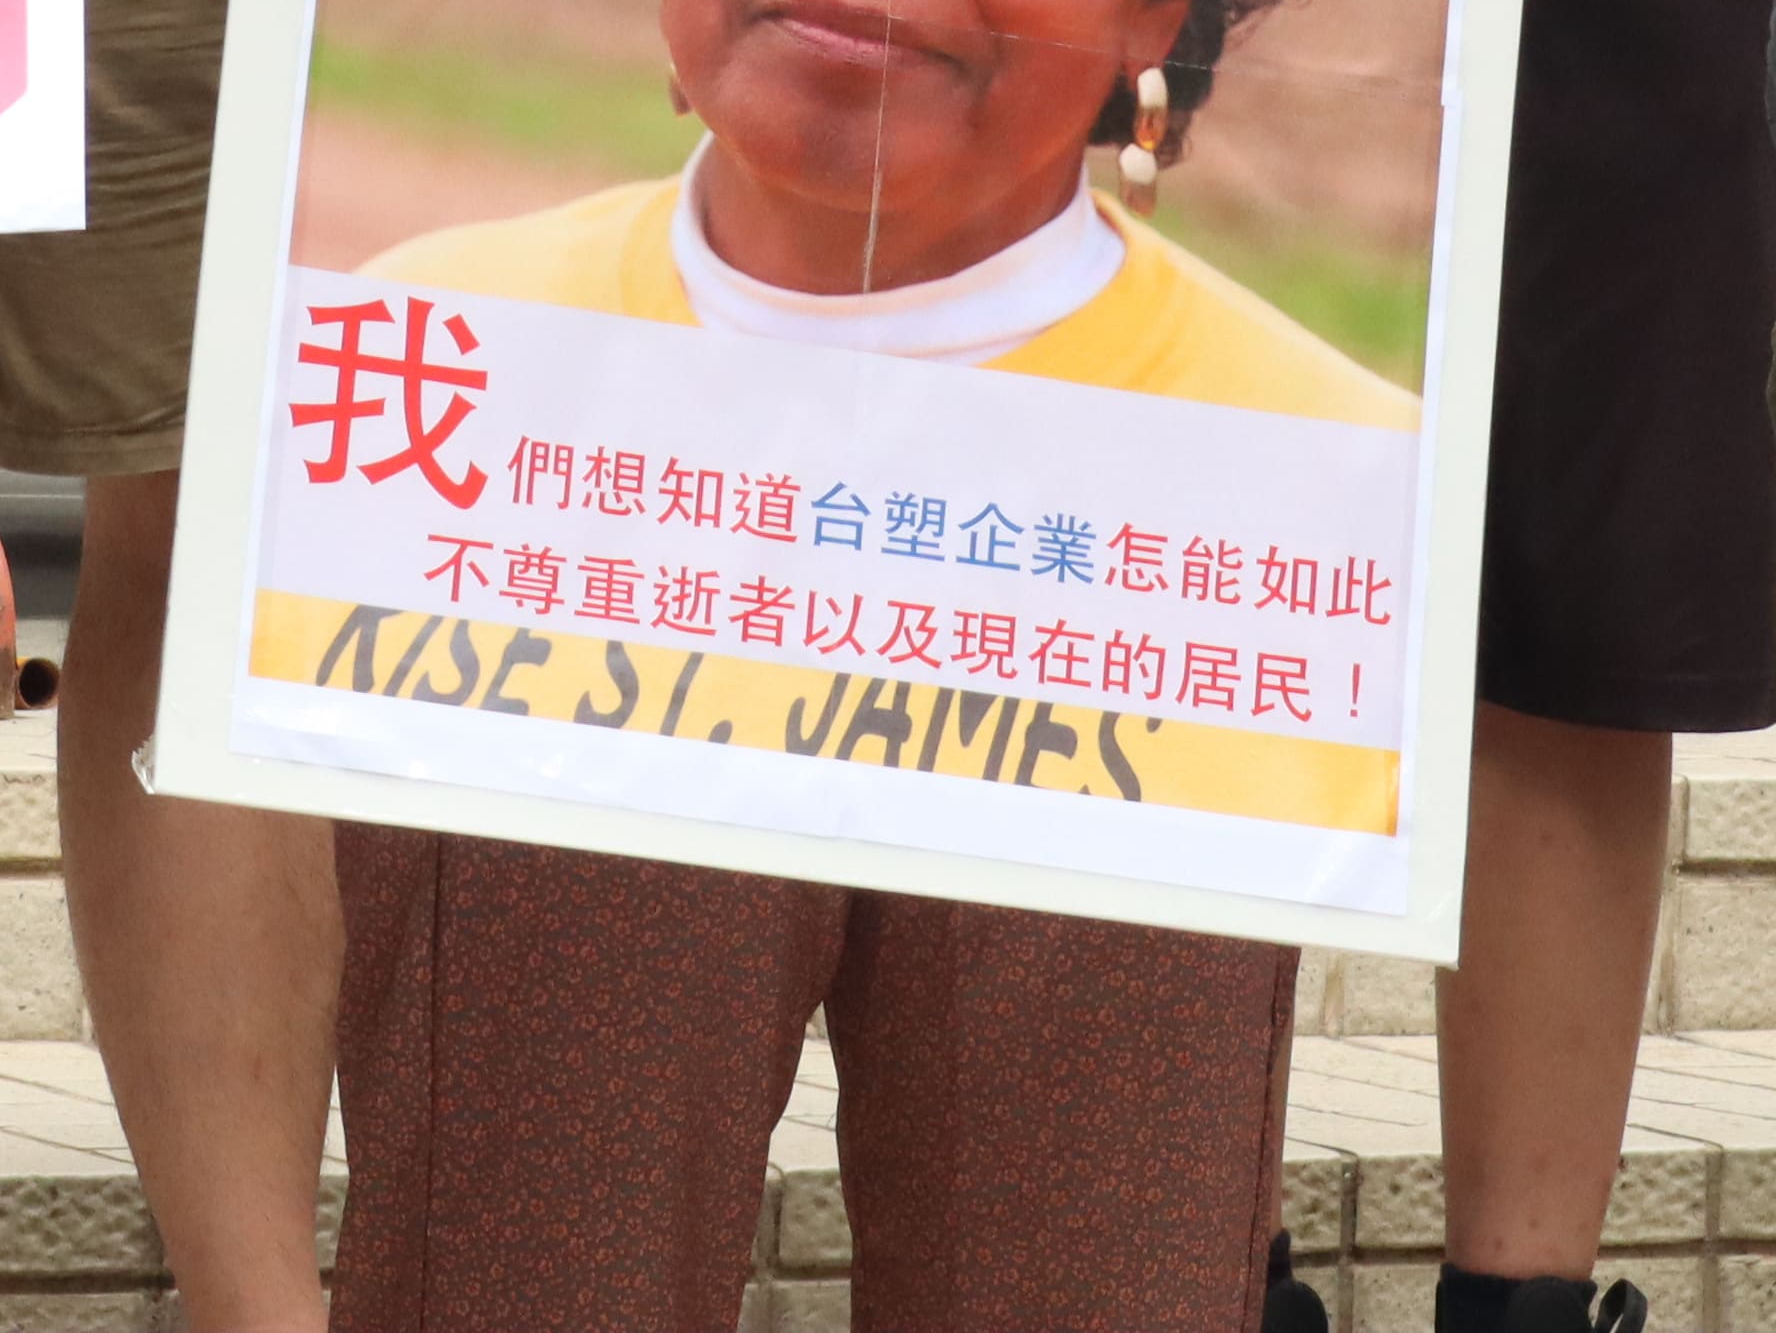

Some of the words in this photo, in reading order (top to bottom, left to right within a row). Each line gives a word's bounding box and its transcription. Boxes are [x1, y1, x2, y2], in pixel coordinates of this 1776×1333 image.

[287, 294, 489, 510] 我
[506, 434, 1396, 629] 們想知道台塑企業怎能如此
